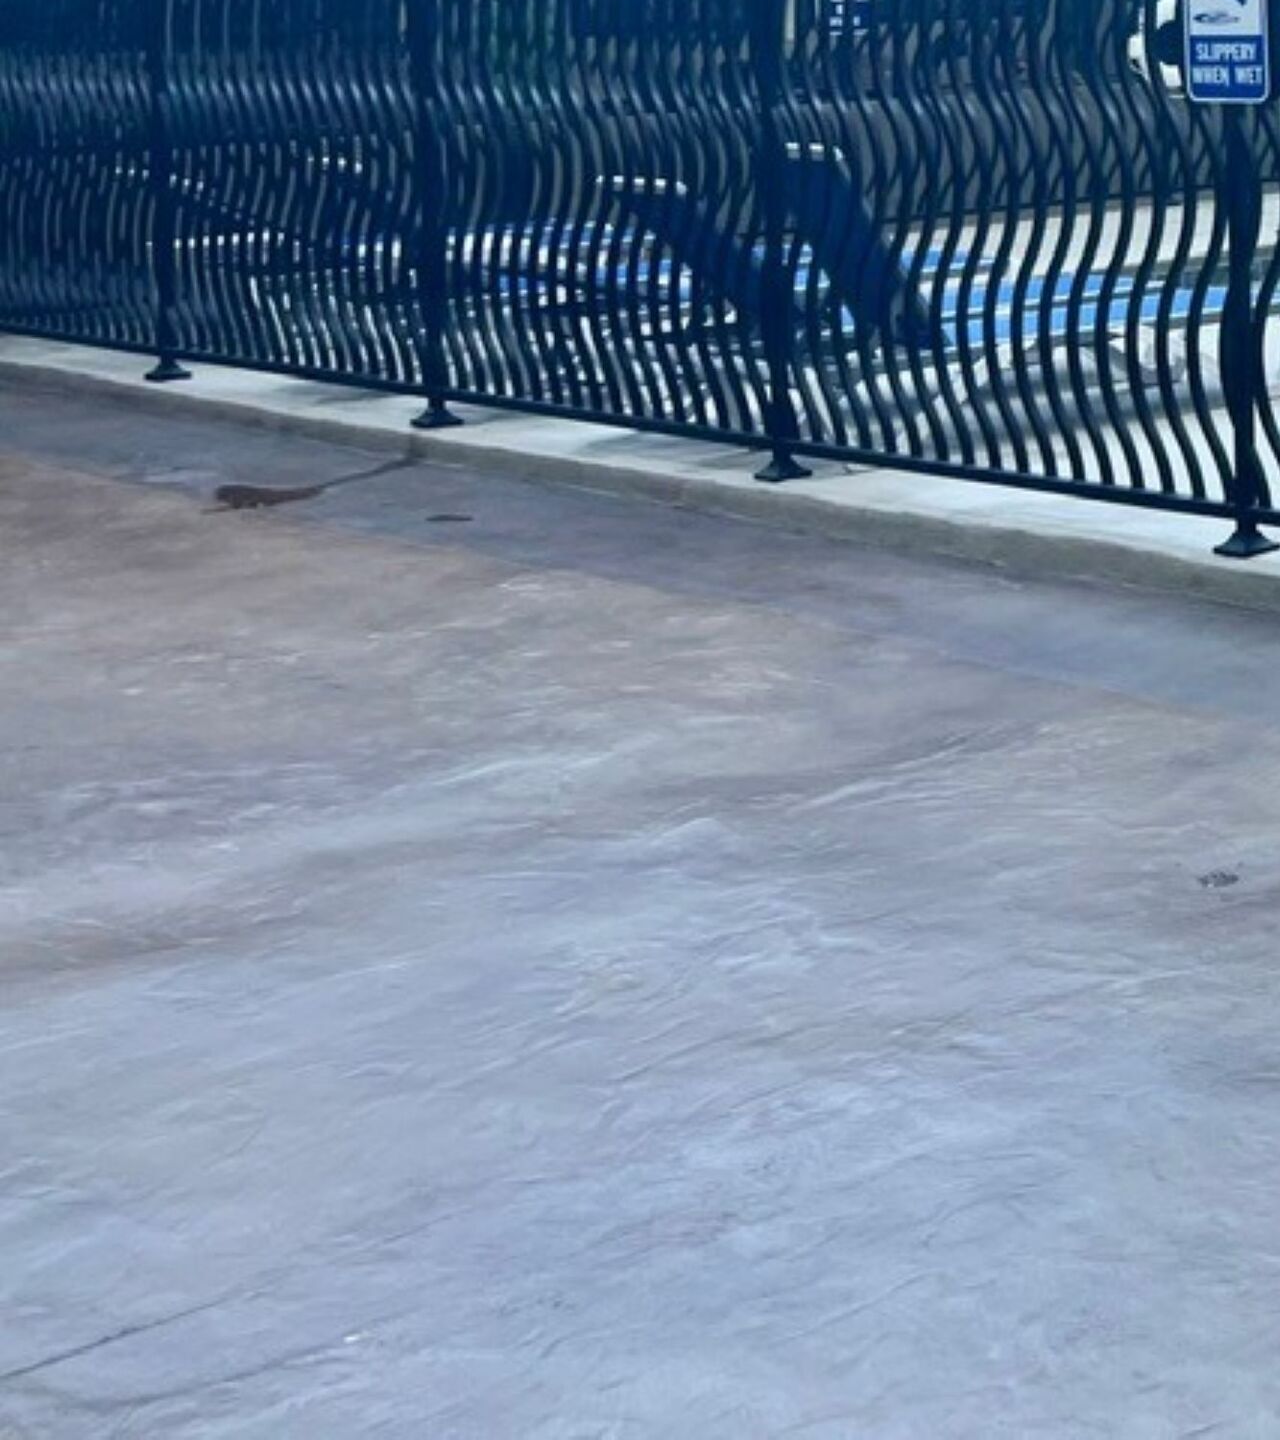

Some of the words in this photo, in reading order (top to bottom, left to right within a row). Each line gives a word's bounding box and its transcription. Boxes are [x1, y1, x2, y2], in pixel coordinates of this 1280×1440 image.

[1195, 43, 1257, 61] SLIPPERY
[1192, 66, 1230, 85] WHEN
[1234, 66, 1264, 85] WET
